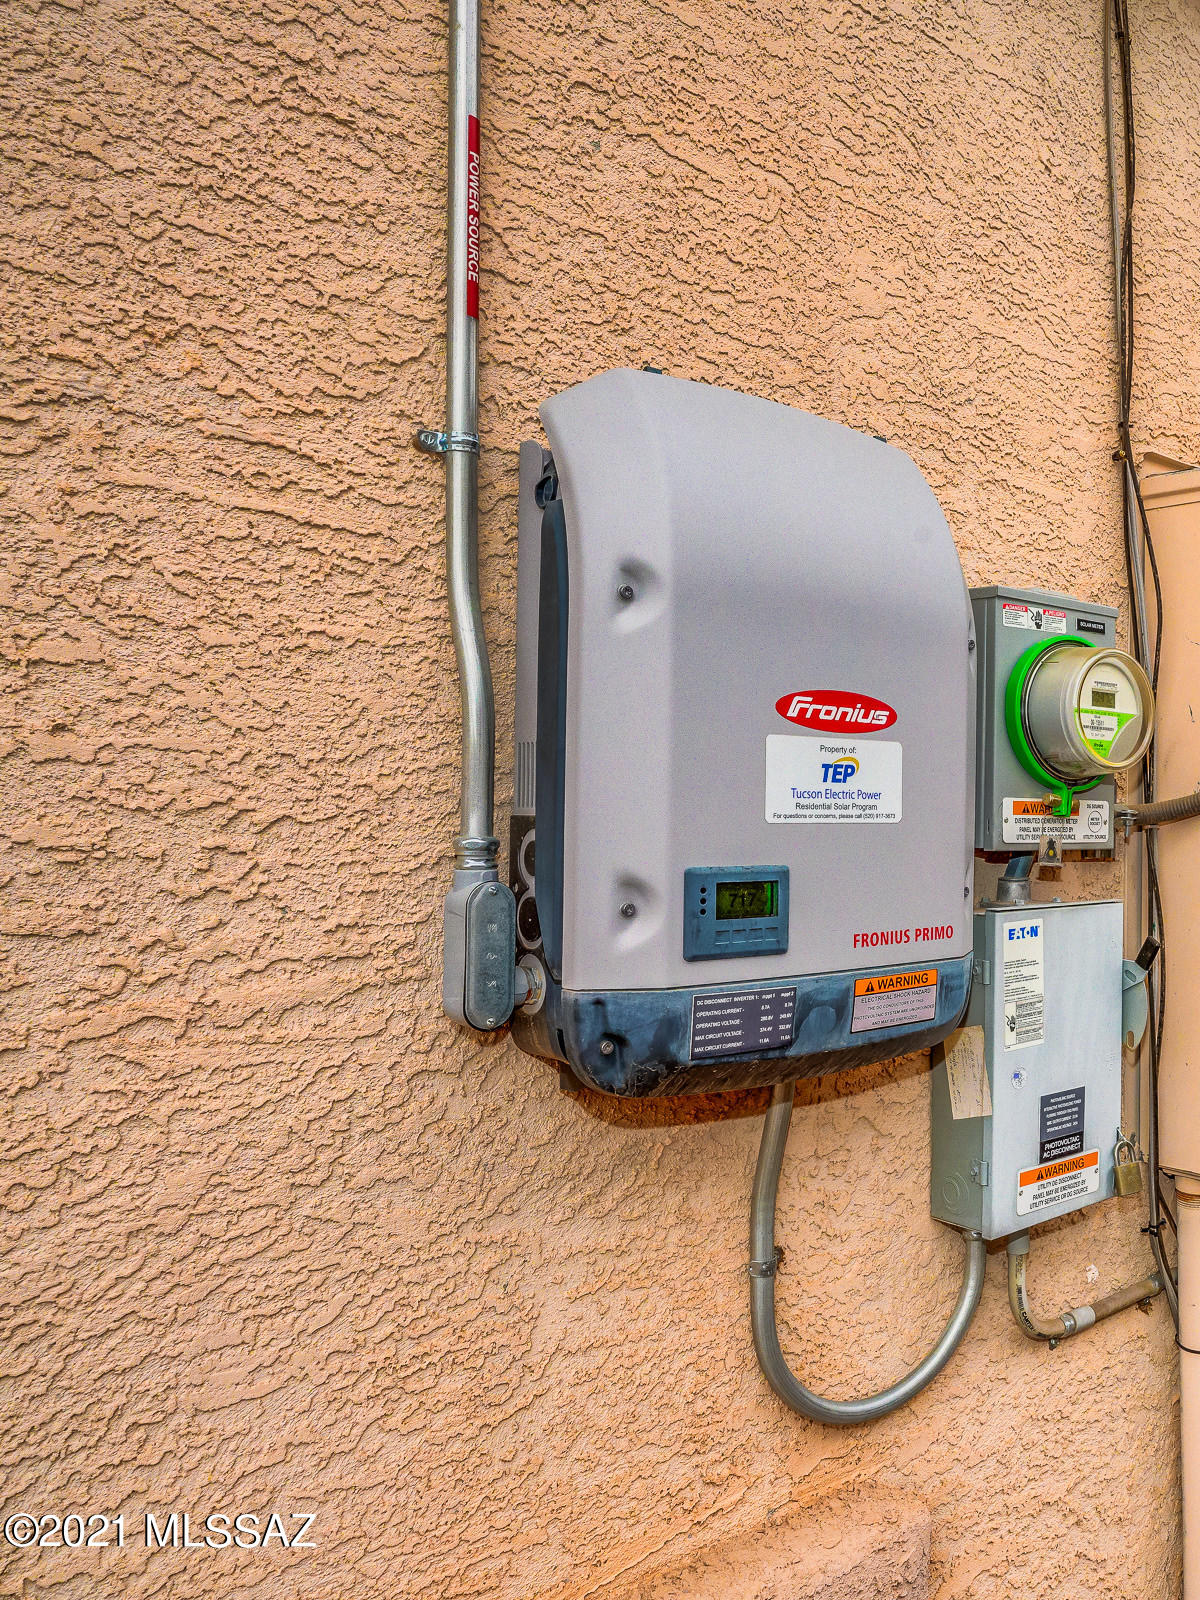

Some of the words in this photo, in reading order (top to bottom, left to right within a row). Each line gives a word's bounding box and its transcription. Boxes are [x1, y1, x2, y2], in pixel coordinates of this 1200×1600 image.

[468, 150, 480, 211] POWER
[467, 214, 480, 283] SOURCE
[1010, 604, 1026, 612] DANGER
[786, 695, 890, 725] Fronius
[820, 744, 847, 755] Property
[848, 746, 857, 754] of:
[821, 763, 856, 784] TEP
[791, 787, 823, 800] Tucson
[824, 788, 856, 800] Electric
[857, 789, 882, 800] Power
[795, 802, 832, 811] Residential
[833, 802, 850, 811] Solar
[851, 803, 878, 812] Program
[852, 928, 911, 949] FRONIUS
[914, 925, 954, 944] PRIMO
[877, 972, 929, 990] WARNING
[703, 997, 732, 1005] DISCONNECT
[860, 993, 892, 1004] ELECTRICAL
[893, 990, 911, 999] SHOCK
[911, 987, 931, 996] HAZARD
[695, 1009, 722, 1018] OPERATING
[721, 1007, 743, 1015] CURRENT
[882, 1001, 909, 1009] CONDUCTORS
[695, 1021, 721, 1029] OPERATING
[720, 1018, 740, 1027] VOLTAGE
[705, 1032, 723, 1040] CIRCUIT
[722, 1029, 742, 1038] VOLTAGE
[704, 1043, 722, 1052] CIRCUIT
[722, 1041, 743, 1049] CURRENT
[1043, 1150, 1051, 1159] AC
[1050, 1142, 1081, 1158] DISCONNECT
[1044, 1135, 1080, 1151] PHOTOVOLTAIC
[1044, 1157, 1085, 1178] WARNING
[1037, 1181, 1052, 1191] UTILITY
[1058, 1172, 1082, 1185] DISCONNECT
[1029, 1201, 1044, 1210] UTILITY
[1044, 1195, 1060, 1206] SERVICE
[1073, 1185, 1089, 1196] SOURCE
[1032, 1192, 1045, 1201] PANEL
[1045, 1190, 1054, 1198] MAY
[1059, 1181, 1081, 1193] ENERGIZED
